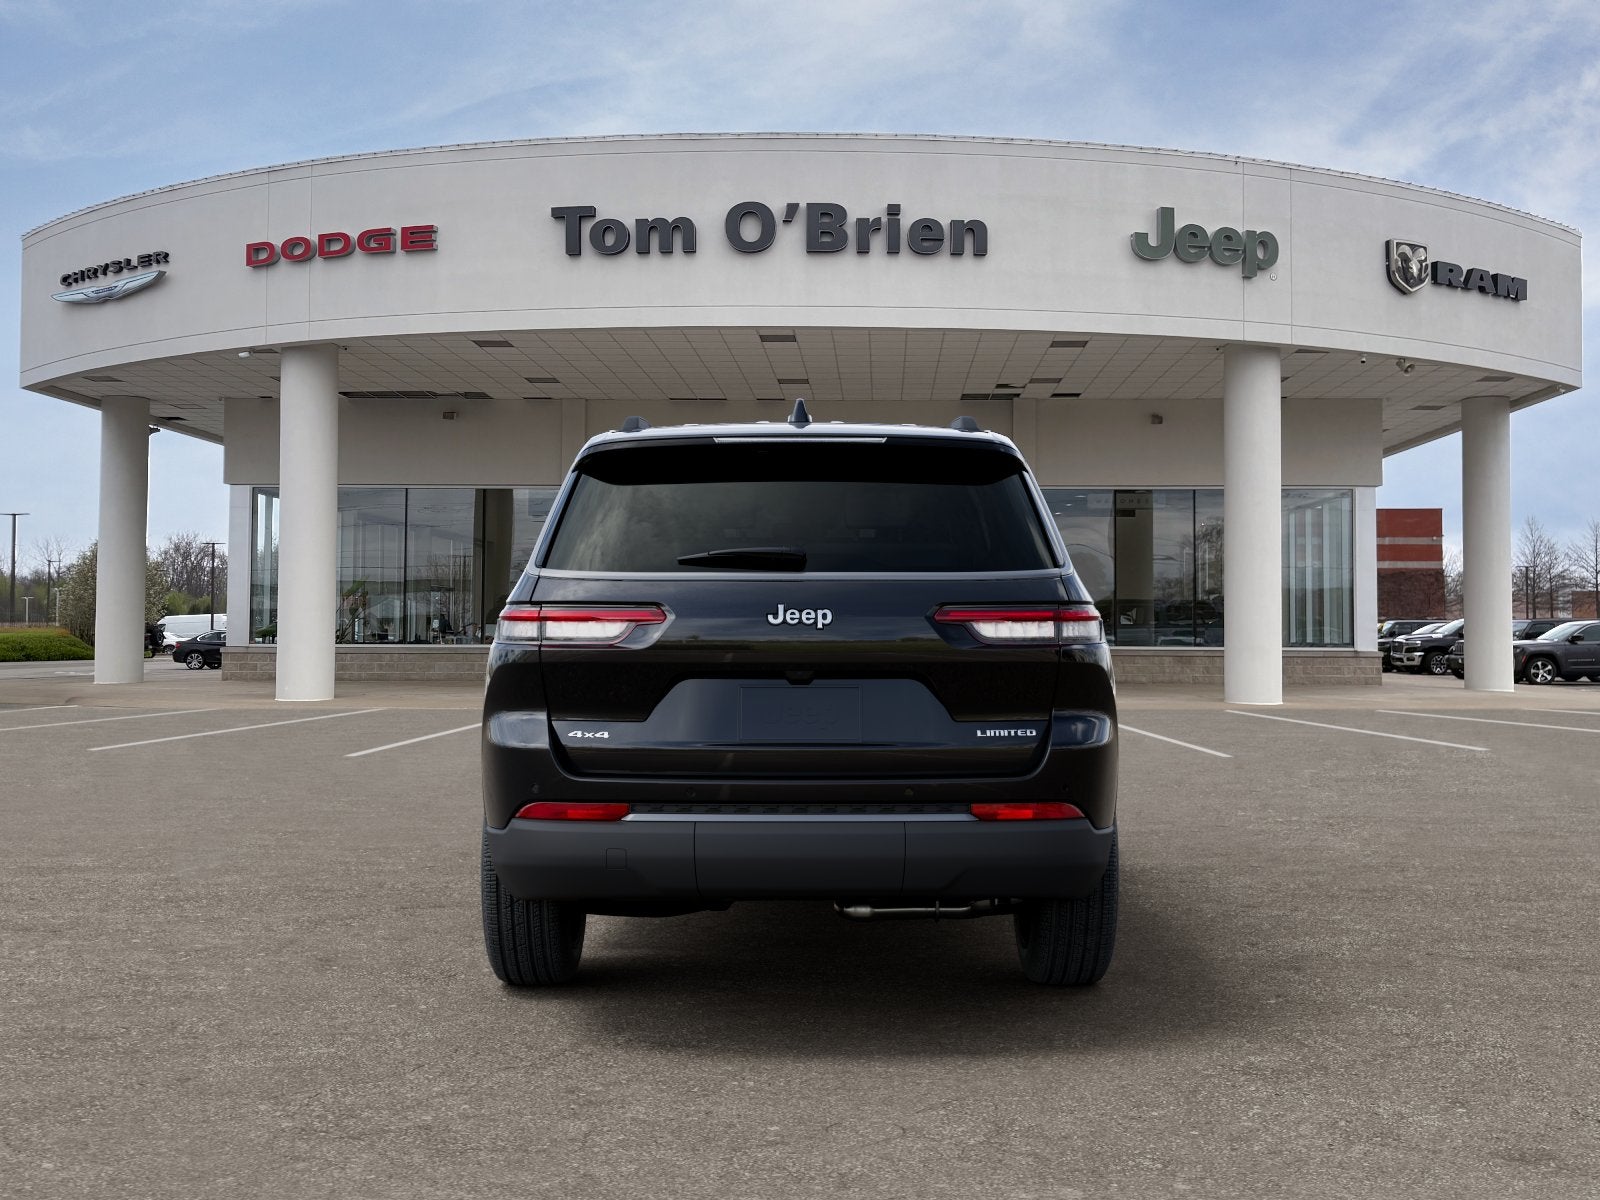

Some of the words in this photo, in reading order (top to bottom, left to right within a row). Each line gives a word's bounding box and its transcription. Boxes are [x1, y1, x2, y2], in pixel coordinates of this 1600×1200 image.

[246, 225, 438, 268] DODGE
[551, 206, 696, 256] Tom
[725, 201, 988, 256] O'Brien
[1131, 207, 1279, 278] Jeep
[60, 250, 170, 287] CHRYSLER
[1431, 261, 1527, 301] RAM
[767, 604, 833, 629] Jeep
[567, 730, 610, 739] 4x4
[976, 729, 1037, 737] LIMITED
